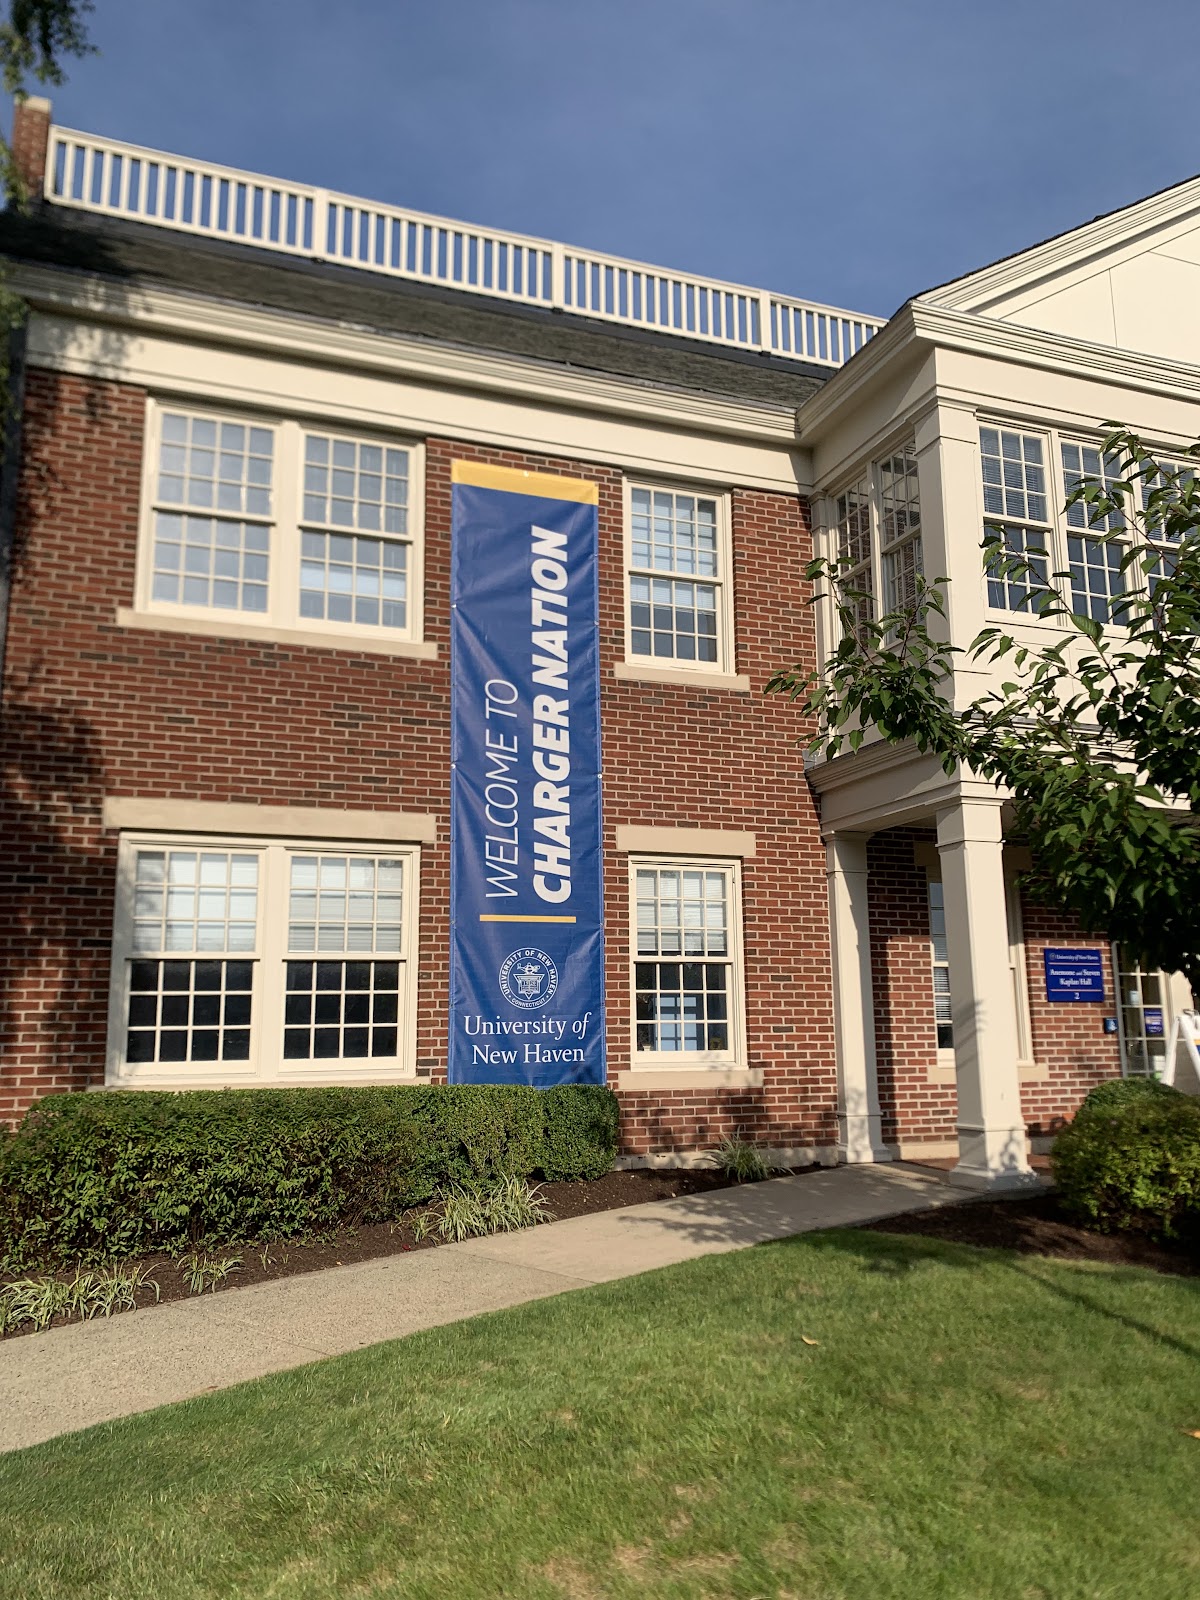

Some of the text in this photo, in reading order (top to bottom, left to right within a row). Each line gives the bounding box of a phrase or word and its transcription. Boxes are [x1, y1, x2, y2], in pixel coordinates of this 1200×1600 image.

[531, 525, 572, 904] CHARGER NATION
[484, 679, 518, 898] WELCOME TO
[501, 952, 522, 995] UNIVERSITY
[537, 953, 552, 967] NEW
[547, 968, 557, 995] HAVEN
[511, 998, 546, 1008] CONNECTICUT
[1074, 992, 1081, 1000] 2
[464, 1011, 592, 1041] University of
[472, 1043, 586, 1065] New Haven
